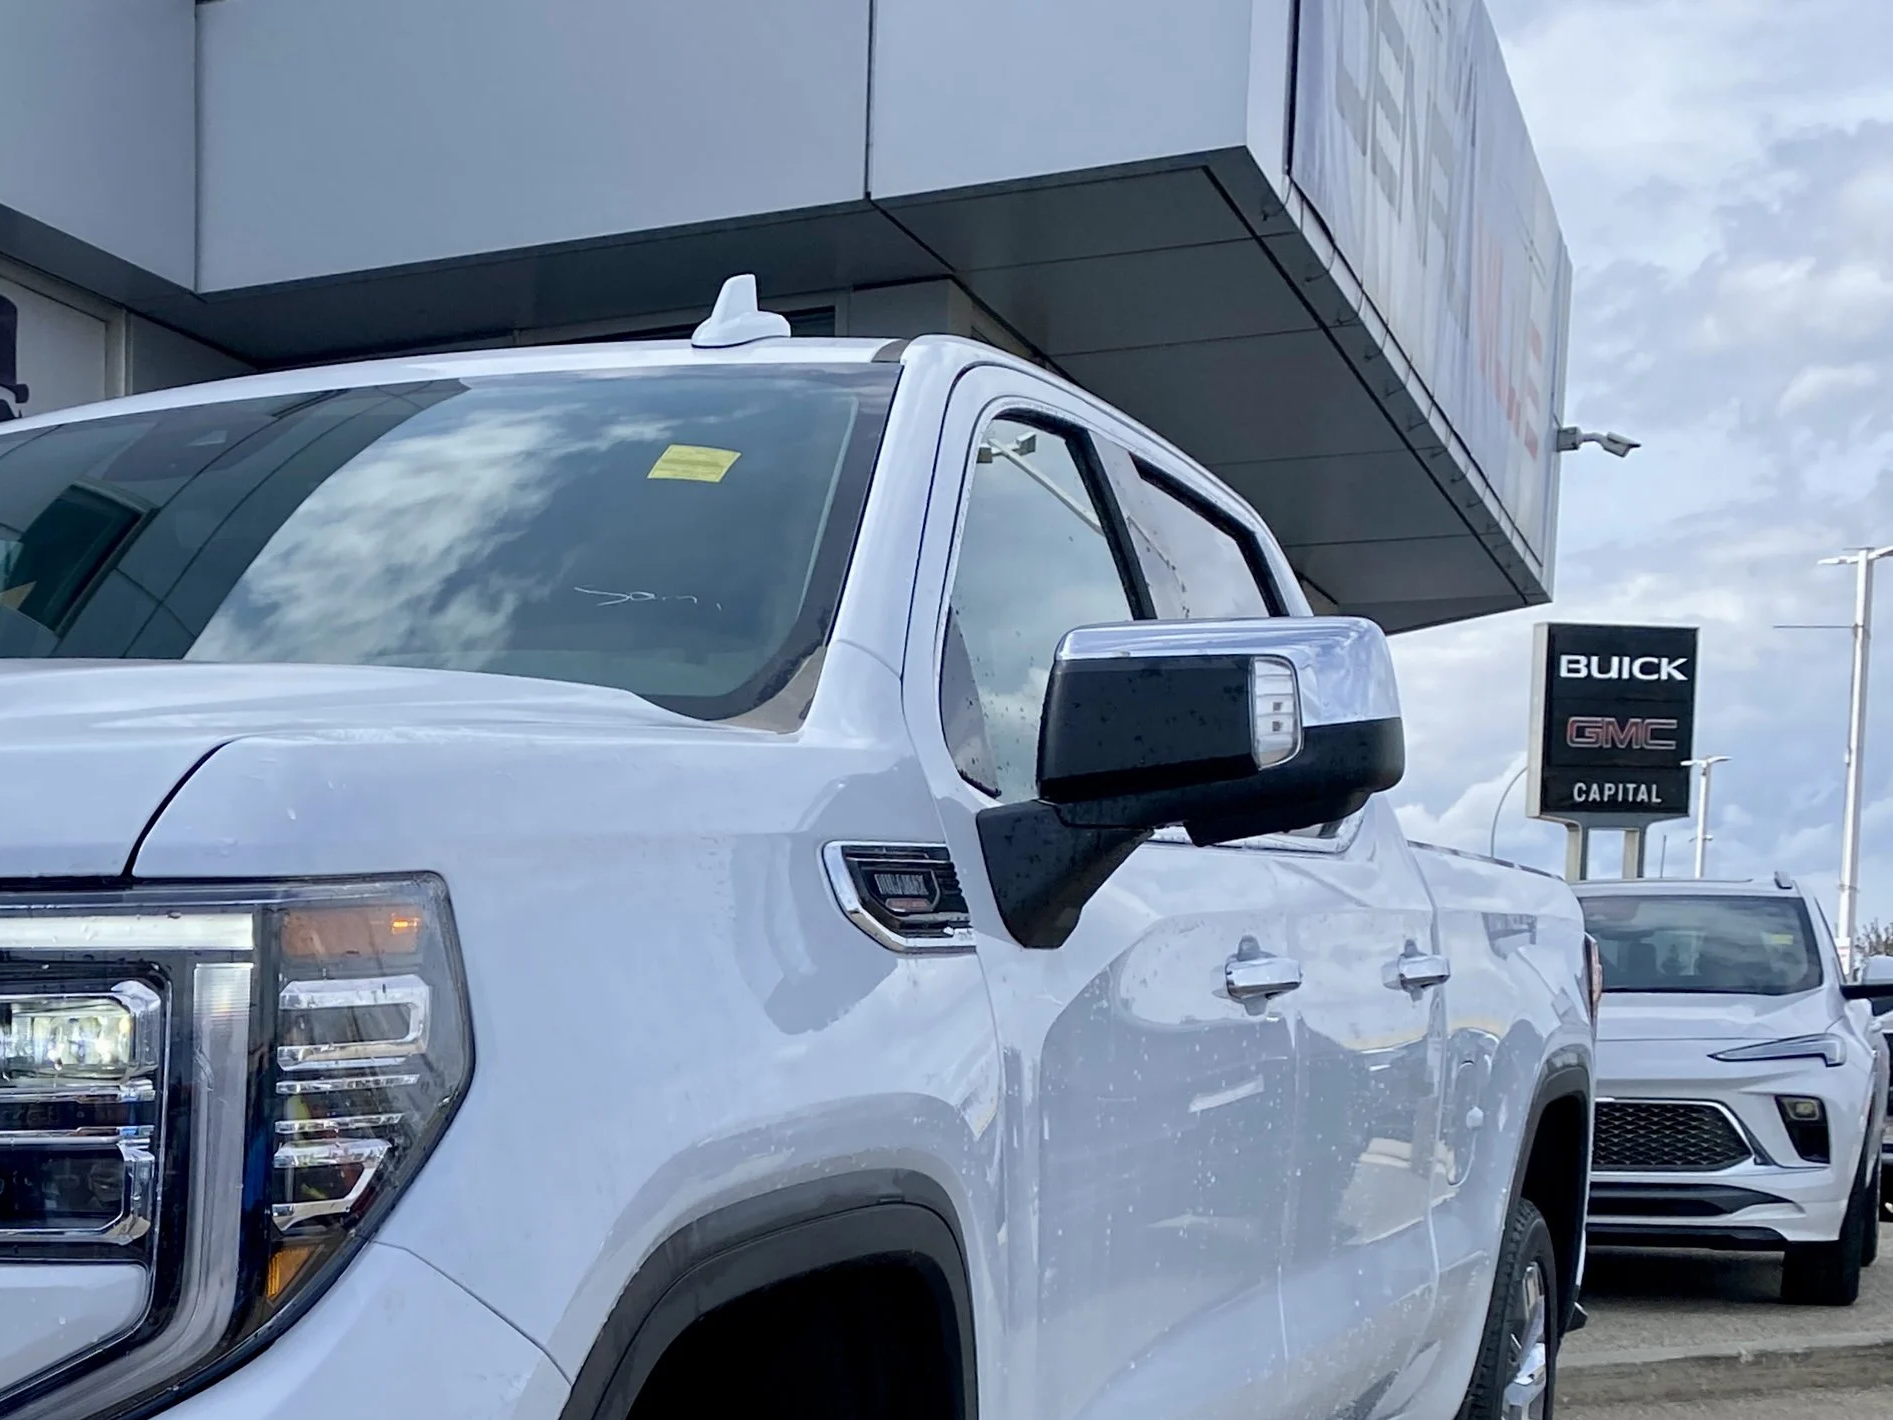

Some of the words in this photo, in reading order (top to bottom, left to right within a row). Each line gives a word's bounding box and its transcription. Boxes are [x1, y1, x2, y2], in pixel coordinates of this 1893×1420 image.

[1559, 653, 1689, 681] BUICK
[1566, 716, 1678, 750] GMC
[1573, 782, 1662, 803] CAPITAL
